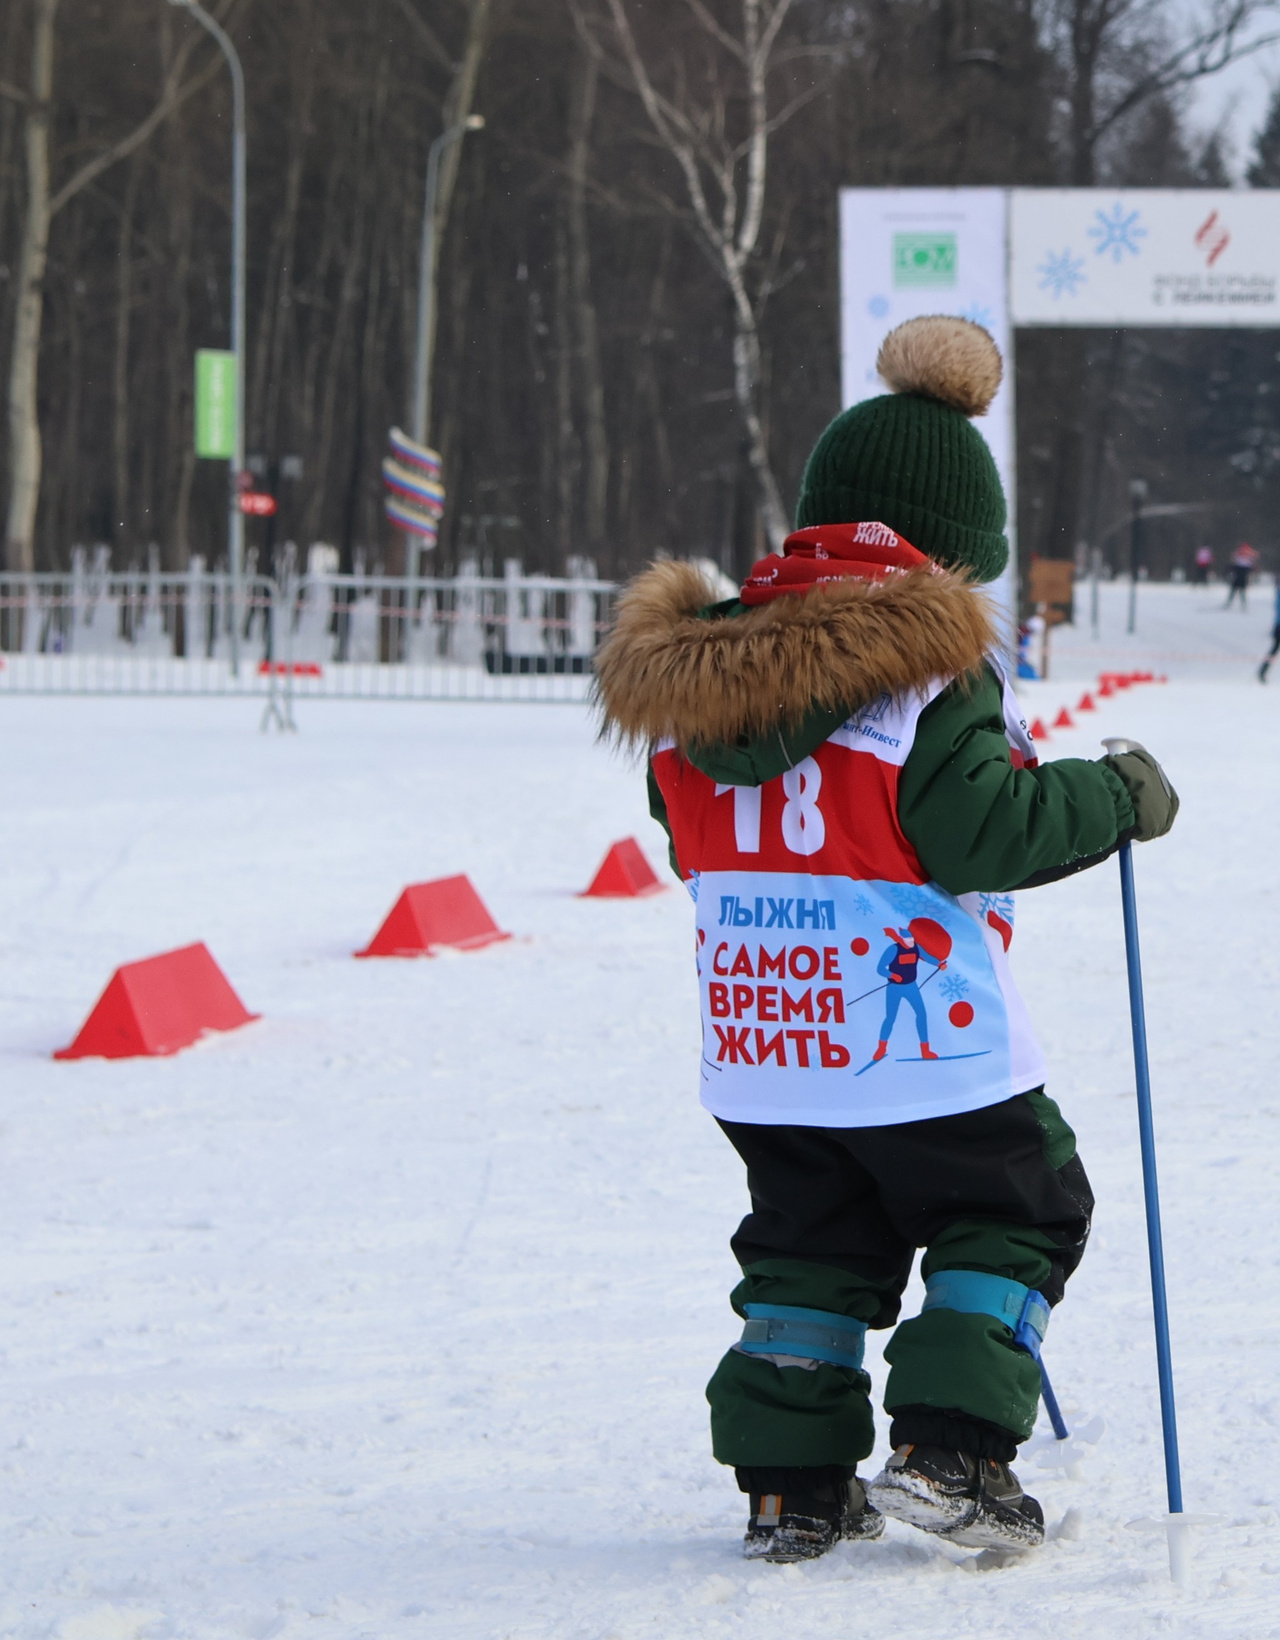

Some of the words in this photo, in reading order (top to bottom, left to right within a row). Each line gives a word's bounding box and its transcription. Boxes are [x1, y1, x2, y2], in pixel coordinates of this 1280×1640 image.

[853, 527, 899, 547] ЖИТЬ
[714, 755, 826, 857] 18
[718, 895, 837, 931] ЛЫЖНЯ
[713, 941, 842, 981] САМОЕ
[709, 982, 846, 1024] ВРЕМЯ
[712, 1024, 850, 1069] ЖИТЬ
